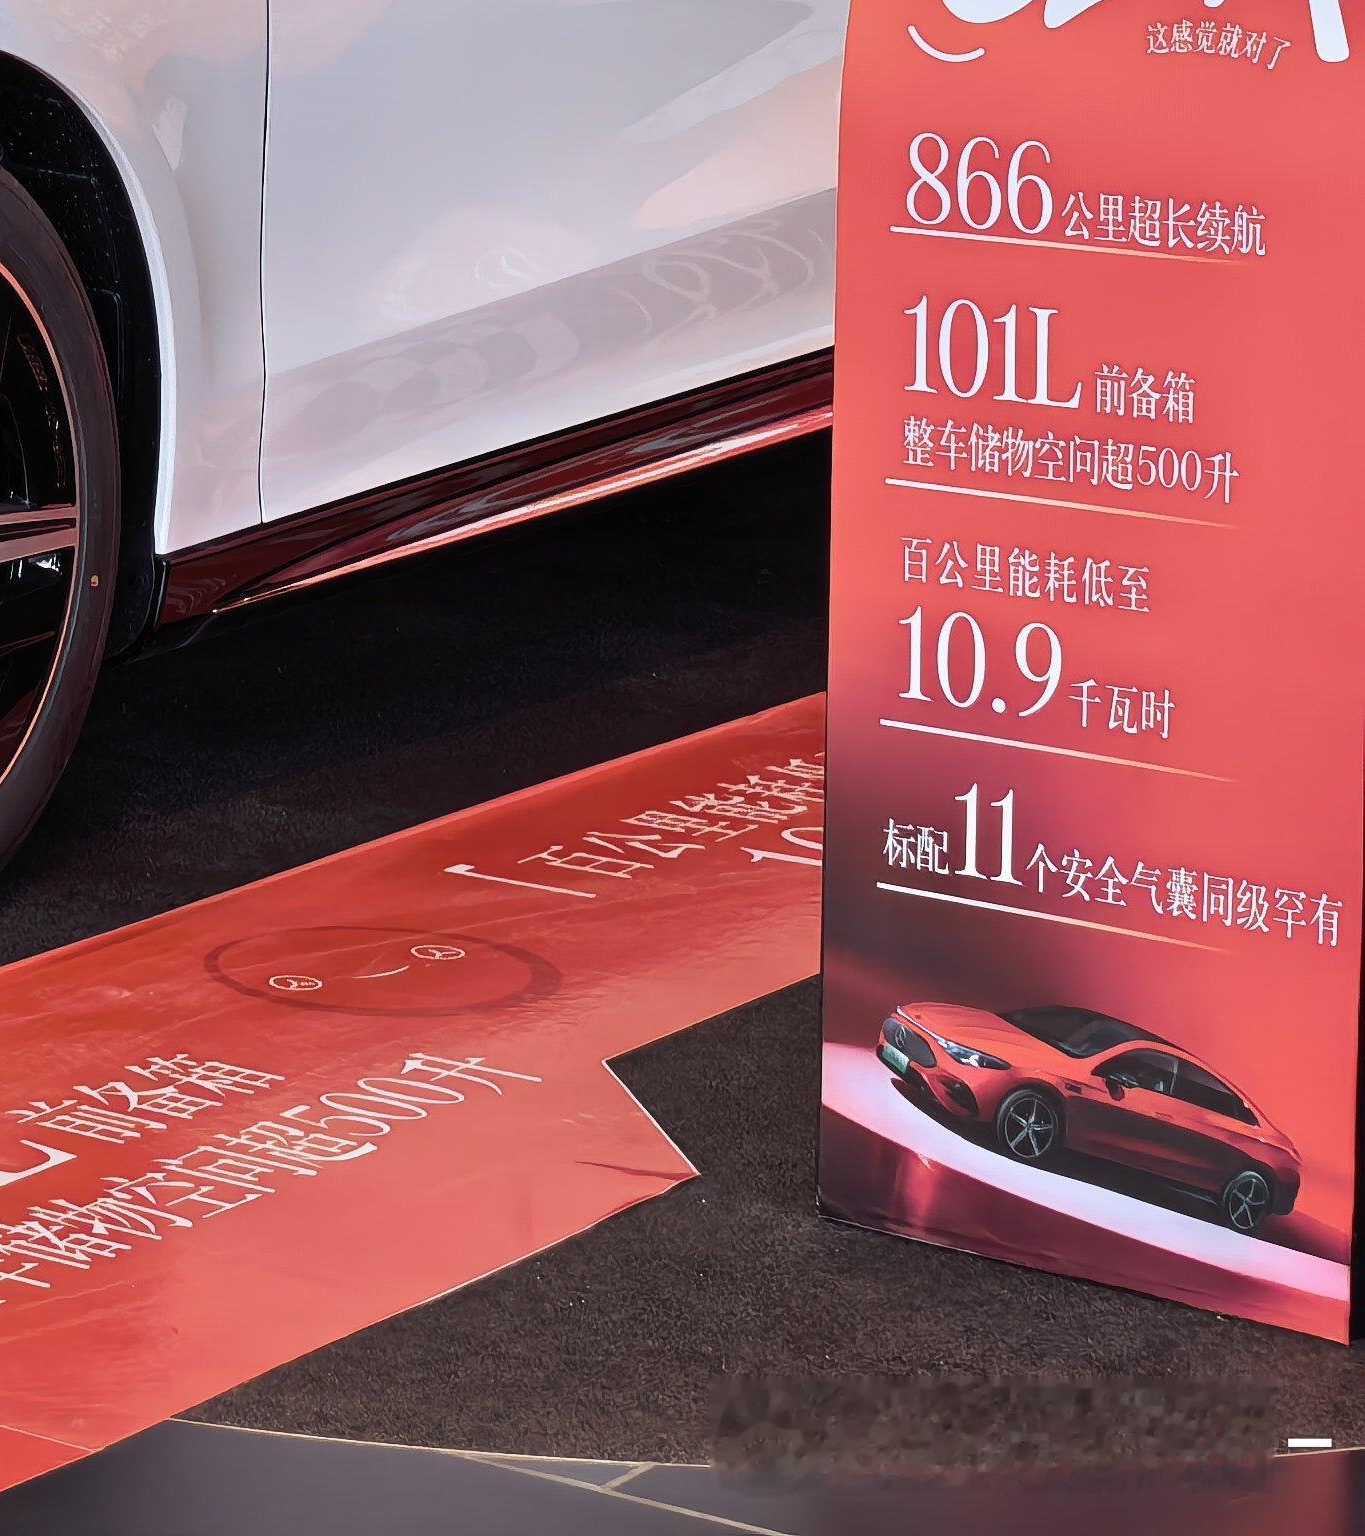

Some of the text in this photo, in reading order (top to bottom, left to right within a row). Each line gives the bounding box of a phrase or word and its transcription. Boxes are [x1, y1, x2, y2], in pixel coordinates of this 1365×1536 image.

[1146, 19, 1292, 71] 这感觉就对了
[900, 536, 1151, 614] 百公里能耗低至
